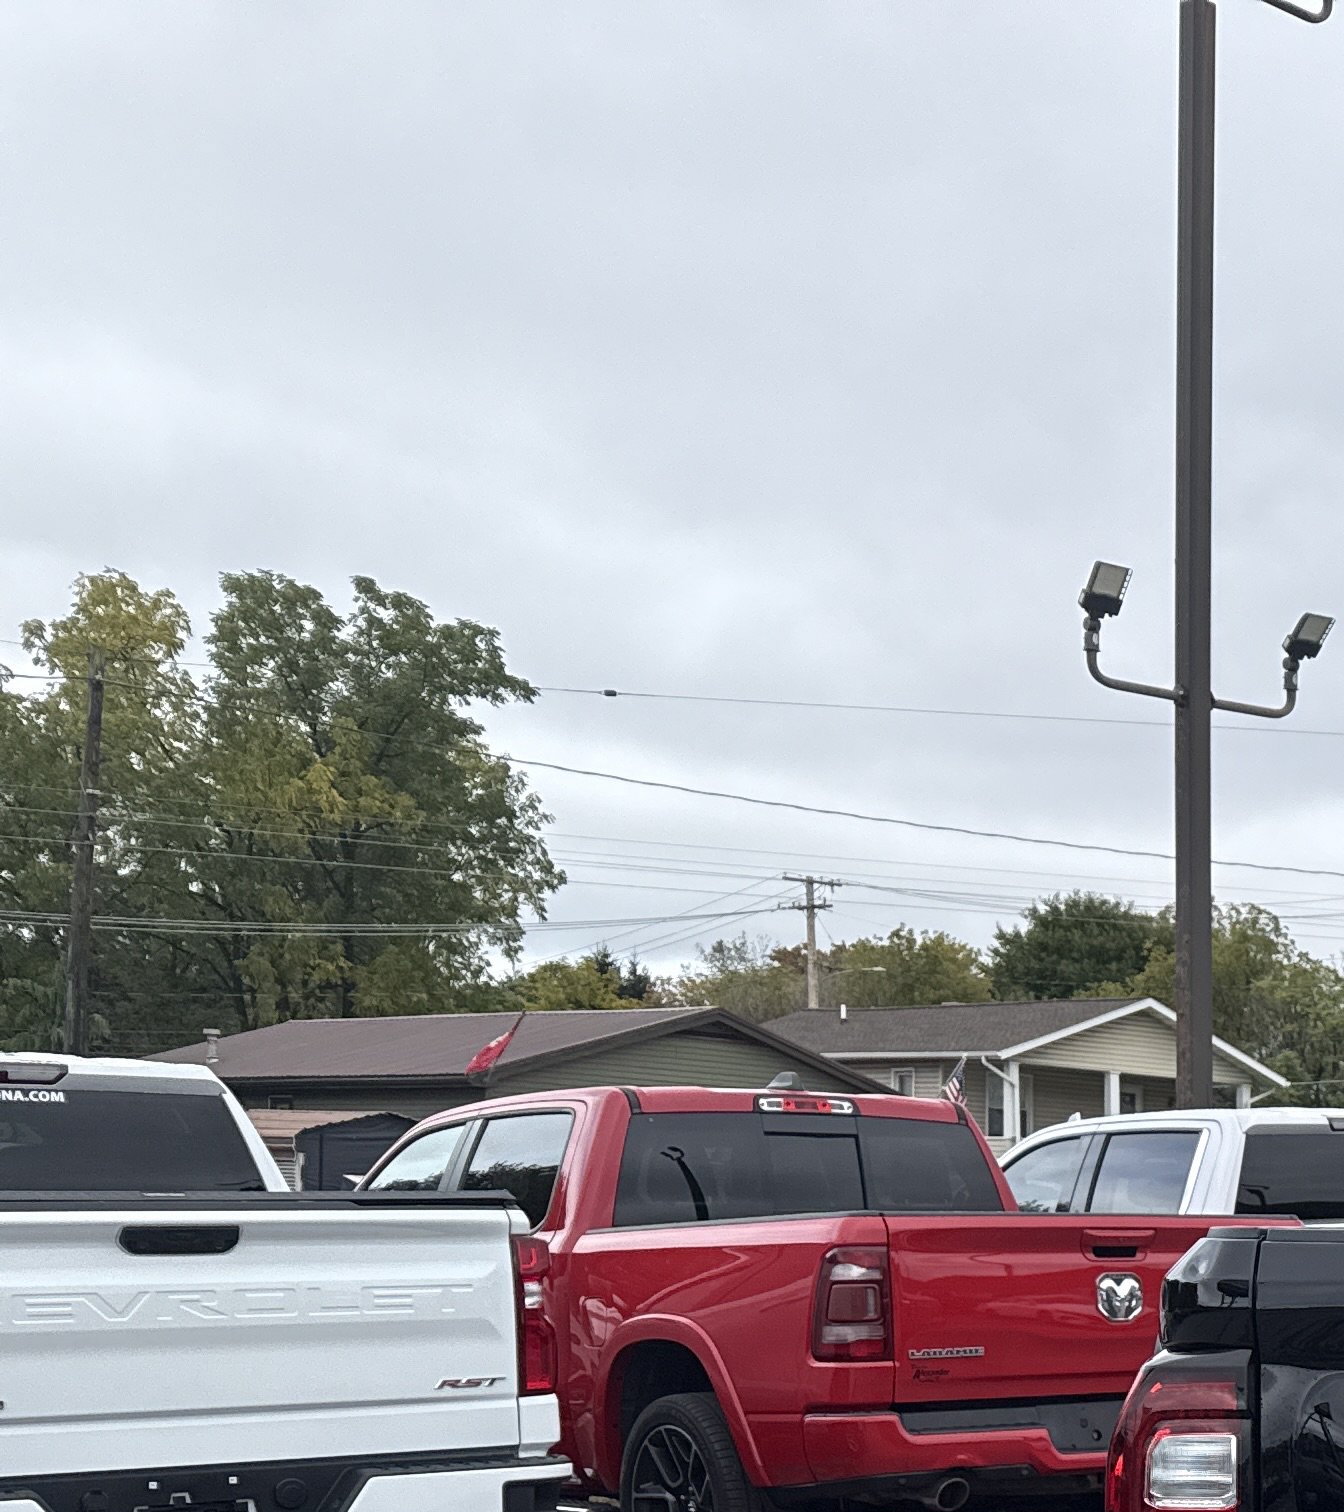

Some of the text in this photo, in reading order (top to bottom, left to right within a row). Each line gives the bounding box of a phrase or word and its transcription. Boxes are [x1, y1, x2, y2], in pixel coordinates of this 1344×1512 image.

[0, 1089, 65, 1103] NA.COM
[0, 1284, 474, 1325] EVROLET
[433, 1376, 507, 1391] RST
